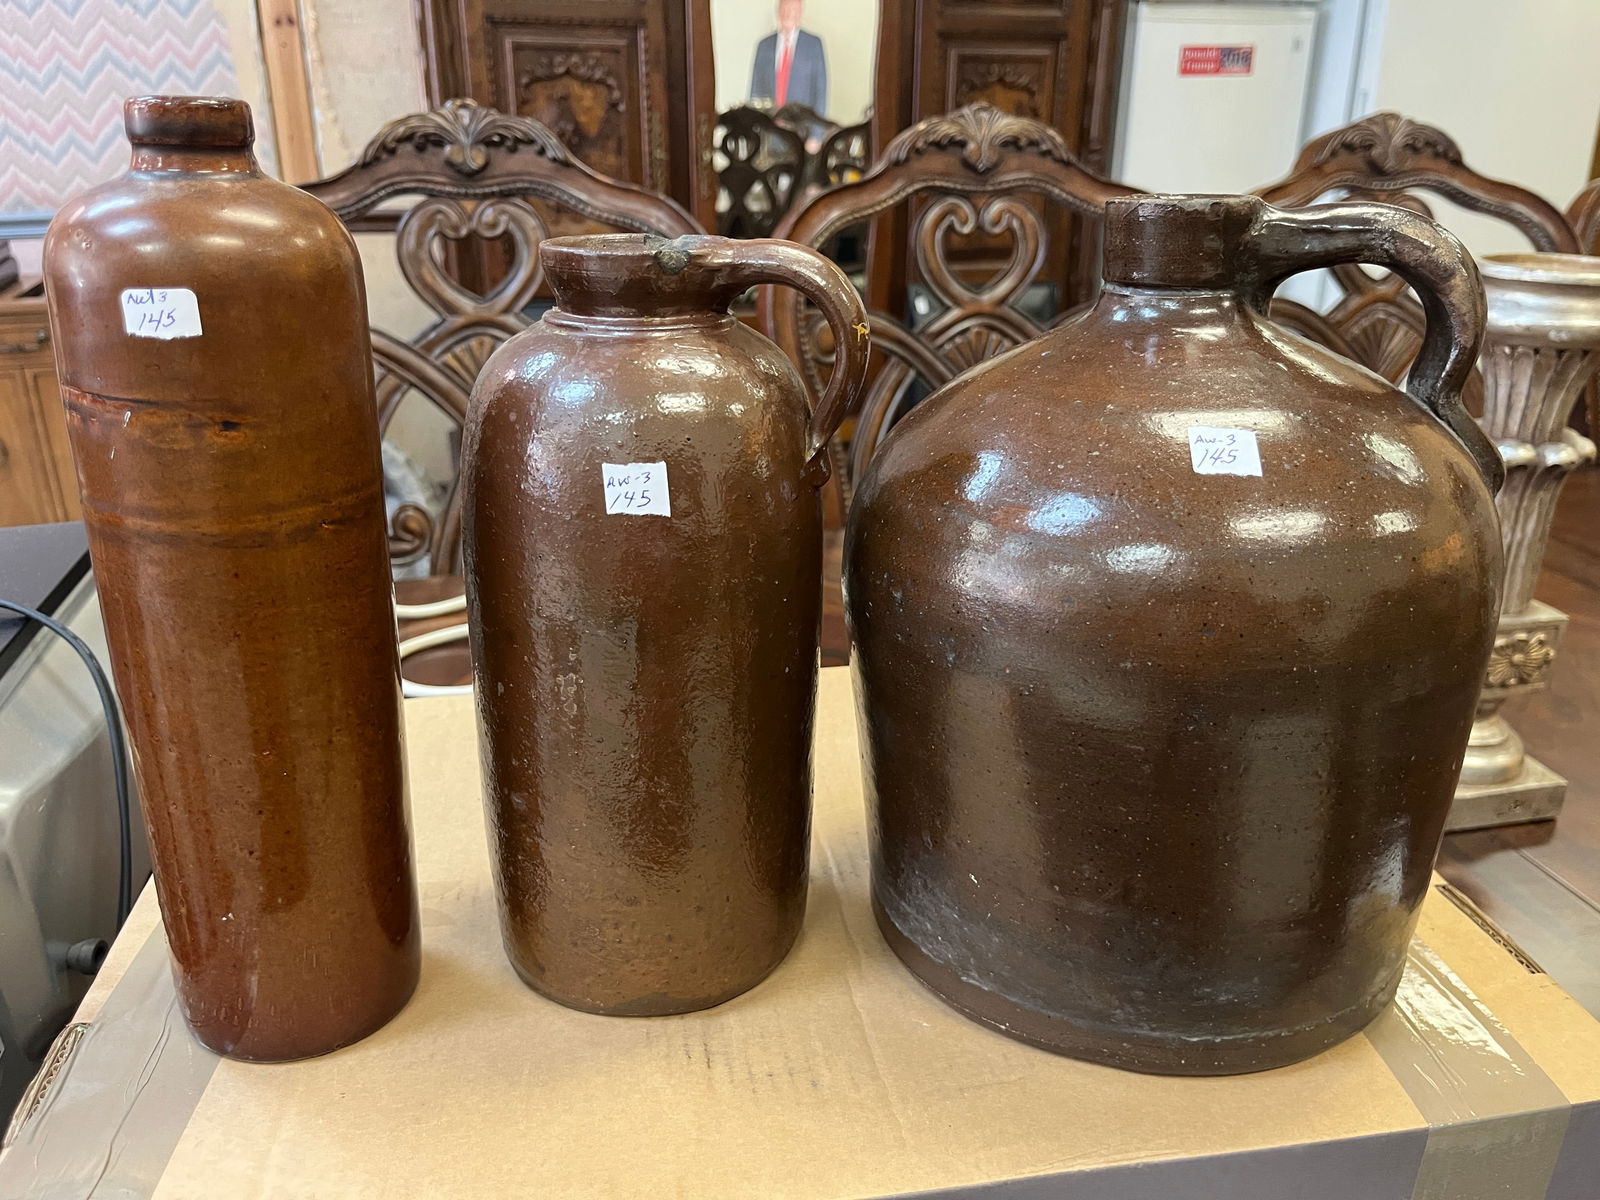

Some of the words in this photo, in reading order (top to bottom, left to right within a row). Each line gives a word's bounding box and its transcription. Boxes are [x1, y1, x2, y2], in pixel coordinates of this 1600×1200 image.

[139, 308, 176, 332] 145
[1197, 448, 1239, 468] 145
[610, 490, 651, 508] 145
